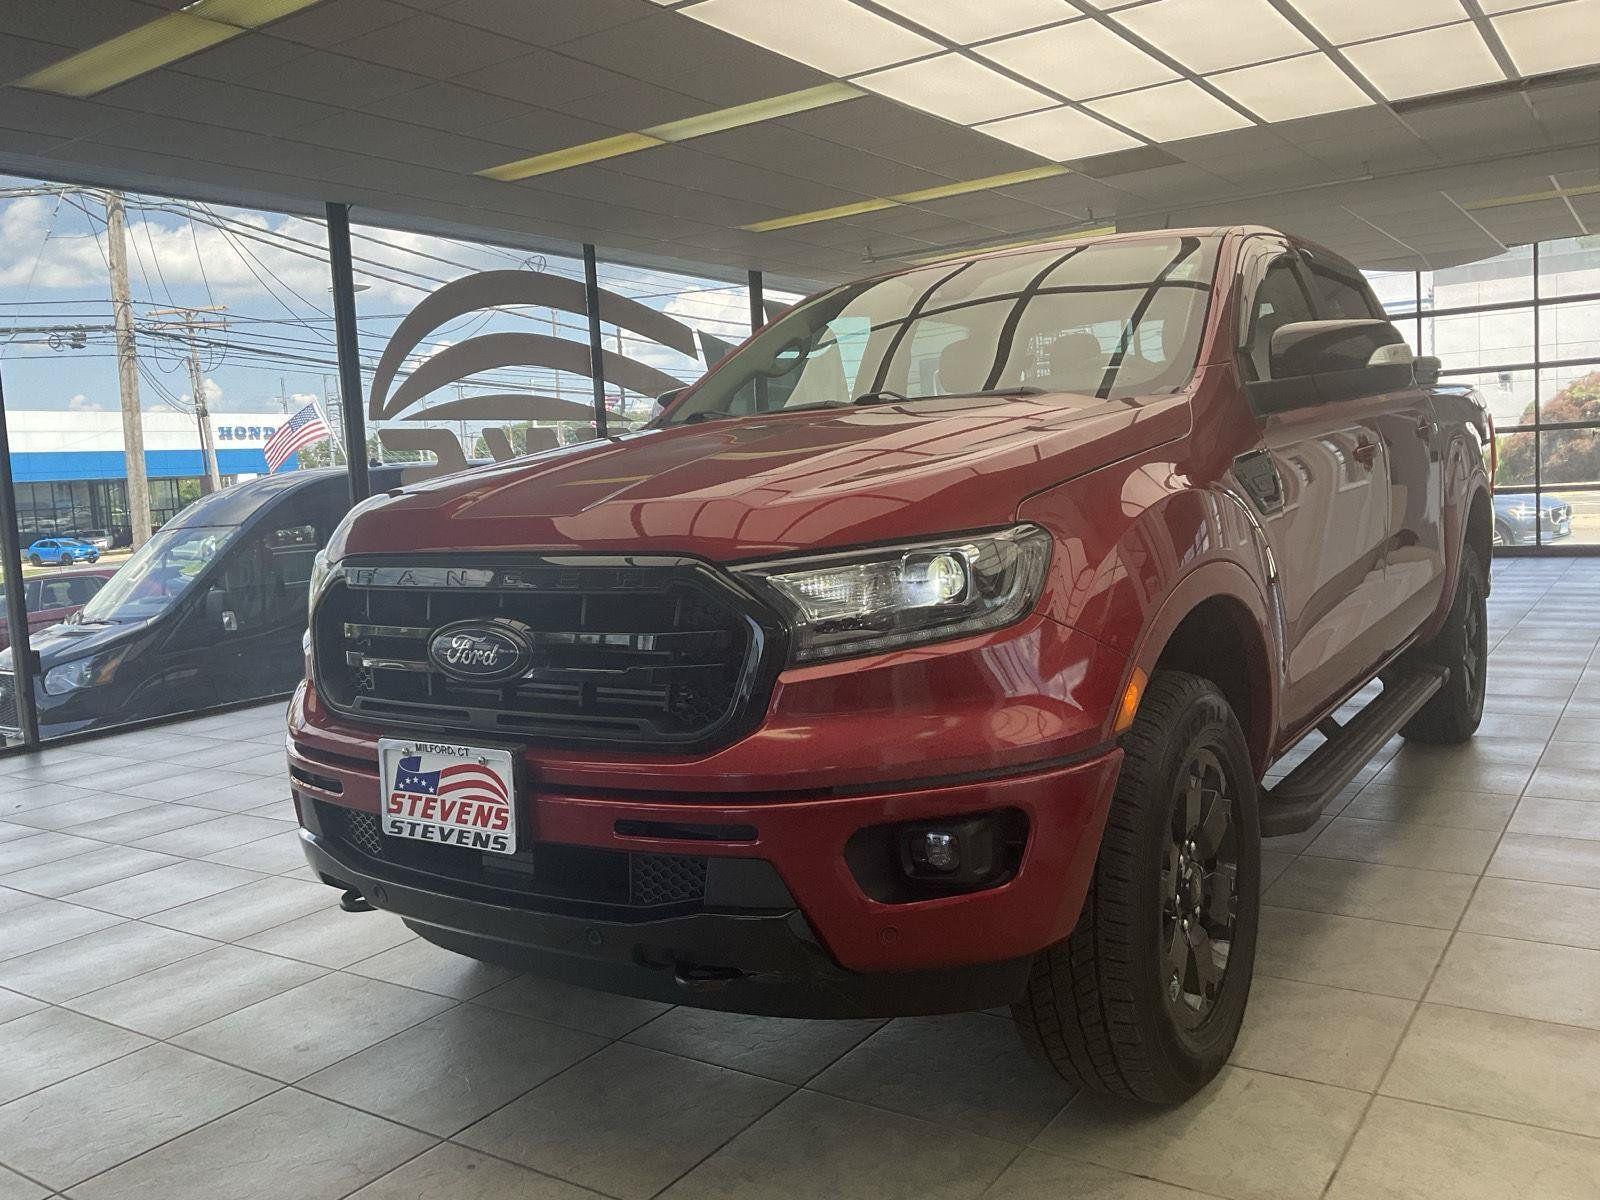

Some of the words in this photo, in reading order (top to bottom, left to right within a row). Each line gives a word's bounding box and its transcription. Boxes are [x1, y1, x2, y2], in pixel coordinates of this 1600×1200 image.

[218, 426, 279, 440] HOND
[446, 634, 500, 666] Ford
[415, 743, 455, 756] MILFORD,
[457, 747, 471, 757] CT
[387, 792, 509, 831] STEVENS
[388, 819, 509, 852] STEVENS
